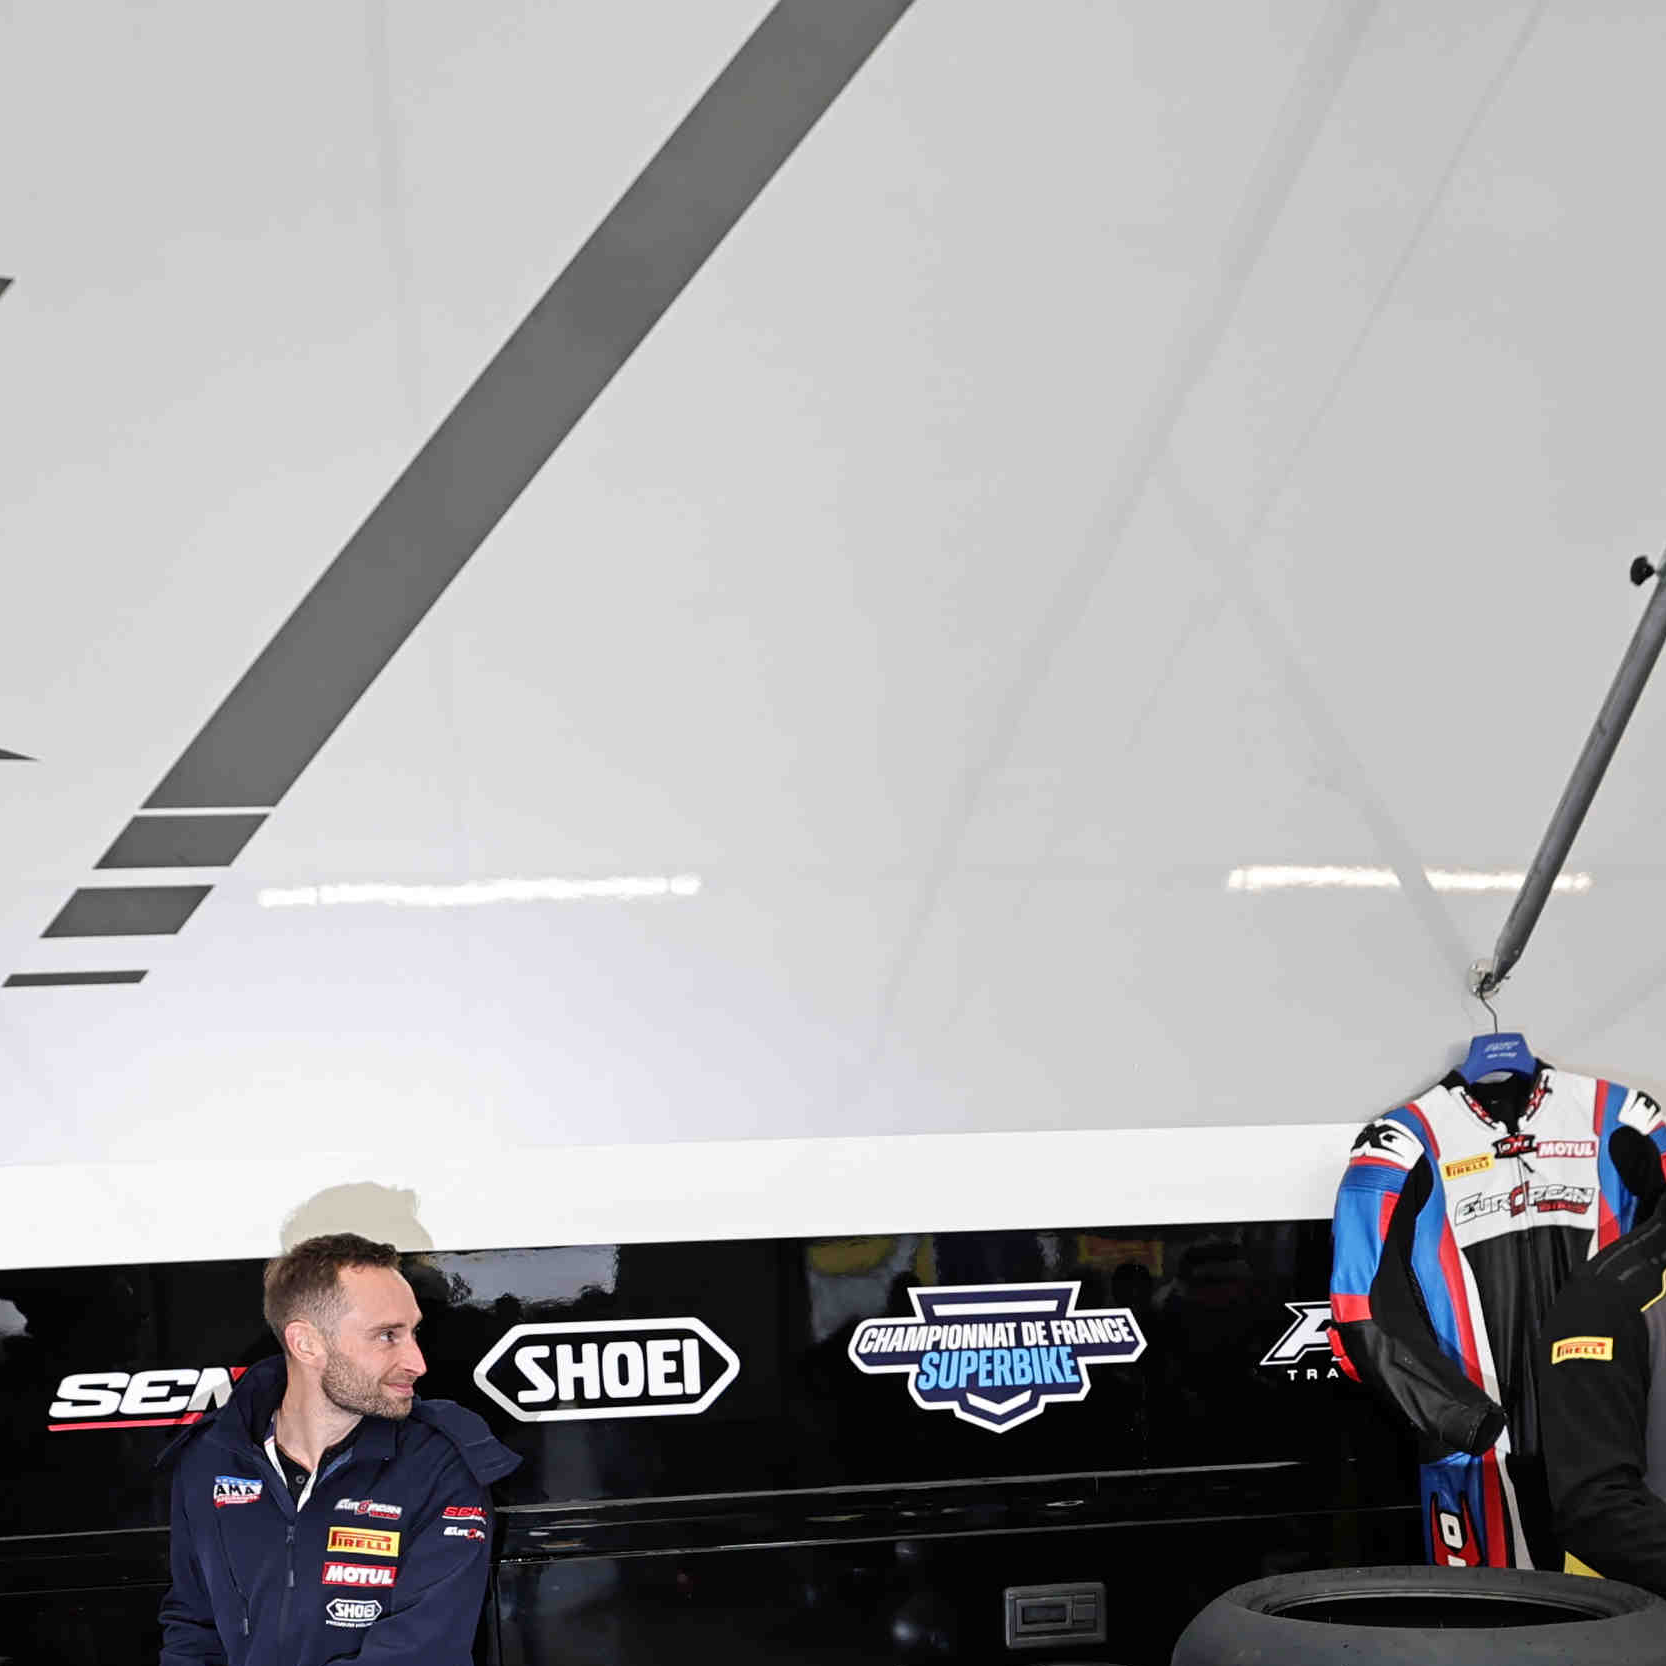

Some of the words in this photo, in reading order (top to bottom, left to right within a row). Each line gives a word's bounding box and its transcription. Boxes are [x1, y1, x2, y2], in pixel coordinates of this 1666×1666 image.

[1538, 1142, 1594, 1156] MOTUL
[858, 1322, 1017, 1354] CHAMPIONNAT
[1022, 1320, 1048, 1346] DE
[1052, 1317, 1135, 1345] FRANCE
[1556, 1340, 1607, 1358] PIRELLI
[514, 1338, 701, 1403] SHOEI
[917, 1346, 1081, 1391] SUPERBIKE
[216, 1485, 255, 1496] AMA
[332, 1531, 391, 1552] PIRELLI
[325, 1564, 394, 1585] MOTUL
